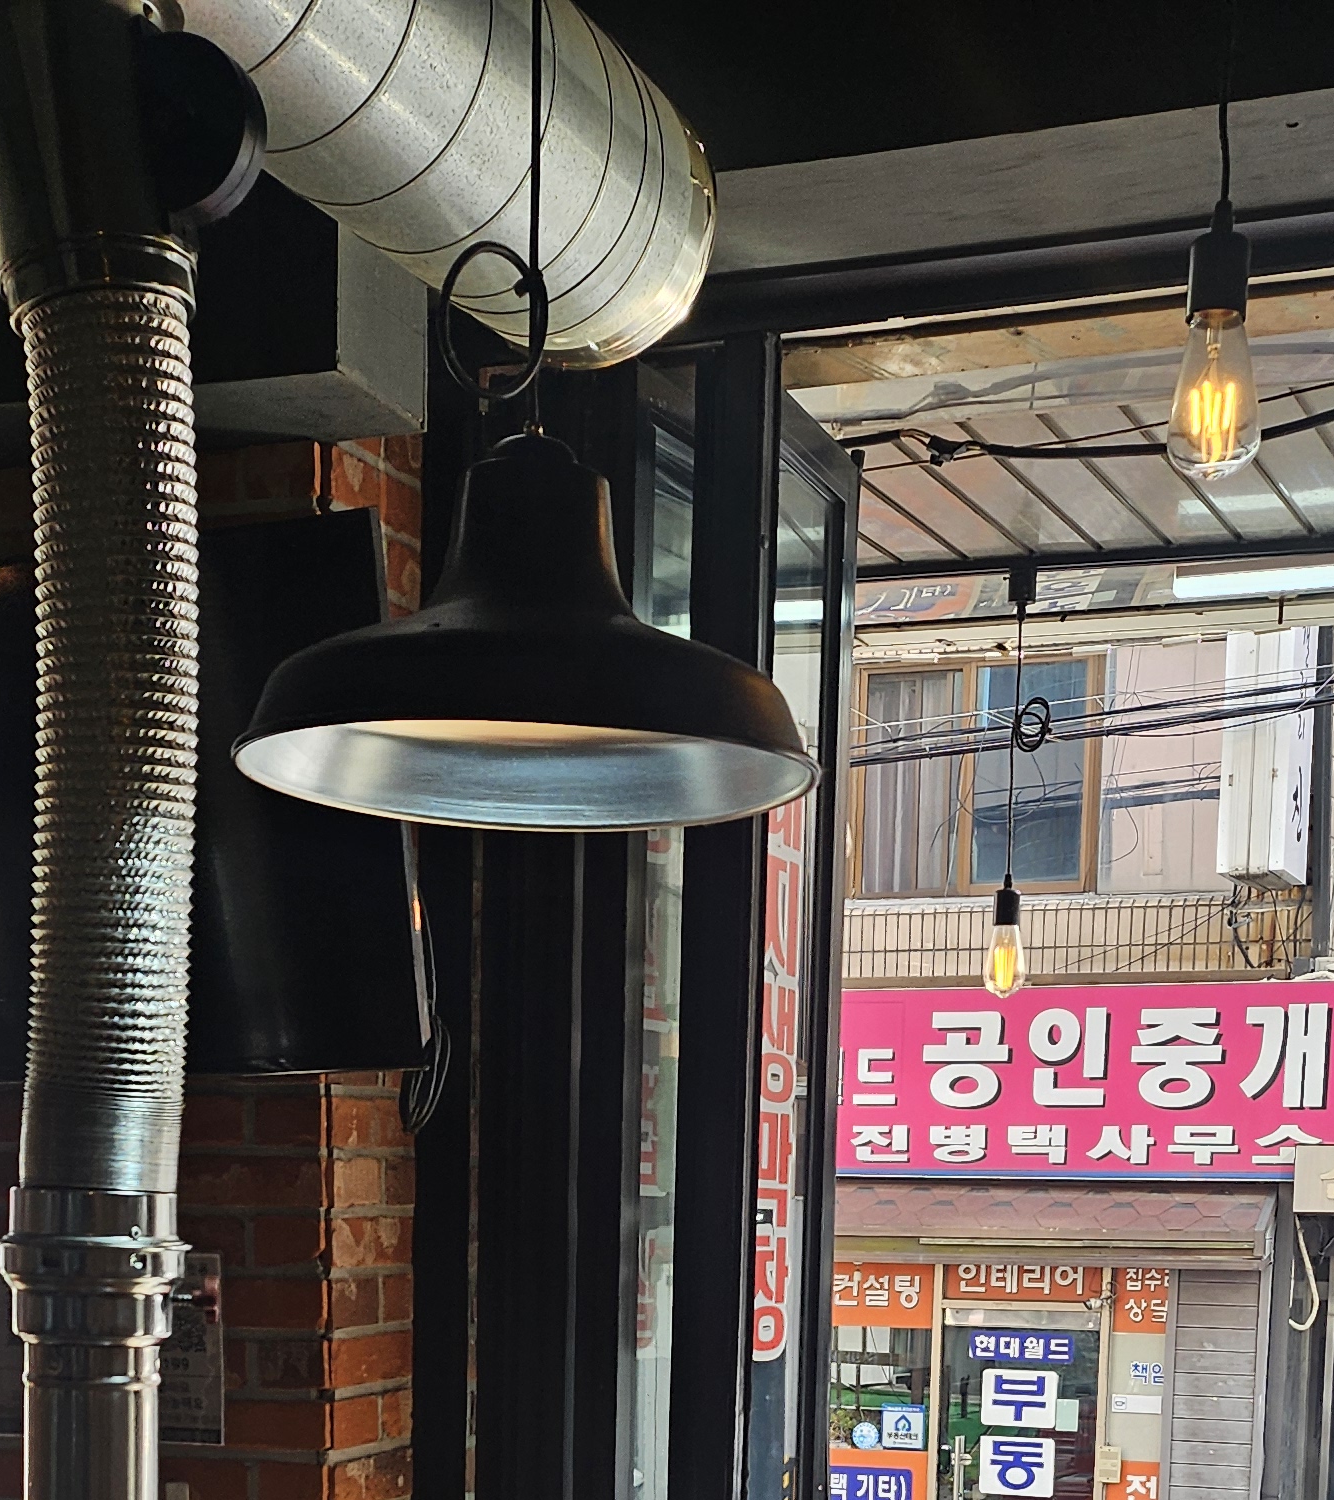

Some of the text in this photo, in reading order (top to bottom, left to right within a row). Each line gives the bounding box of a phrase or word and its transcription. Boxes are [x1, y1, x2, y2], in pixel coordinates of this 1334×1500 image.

[832, 1271, 921, 1310] 컨설팅
[957, 1263, 1085, 1296] 인테리어
[974, 1334, 1070, 1360] 현대월드
